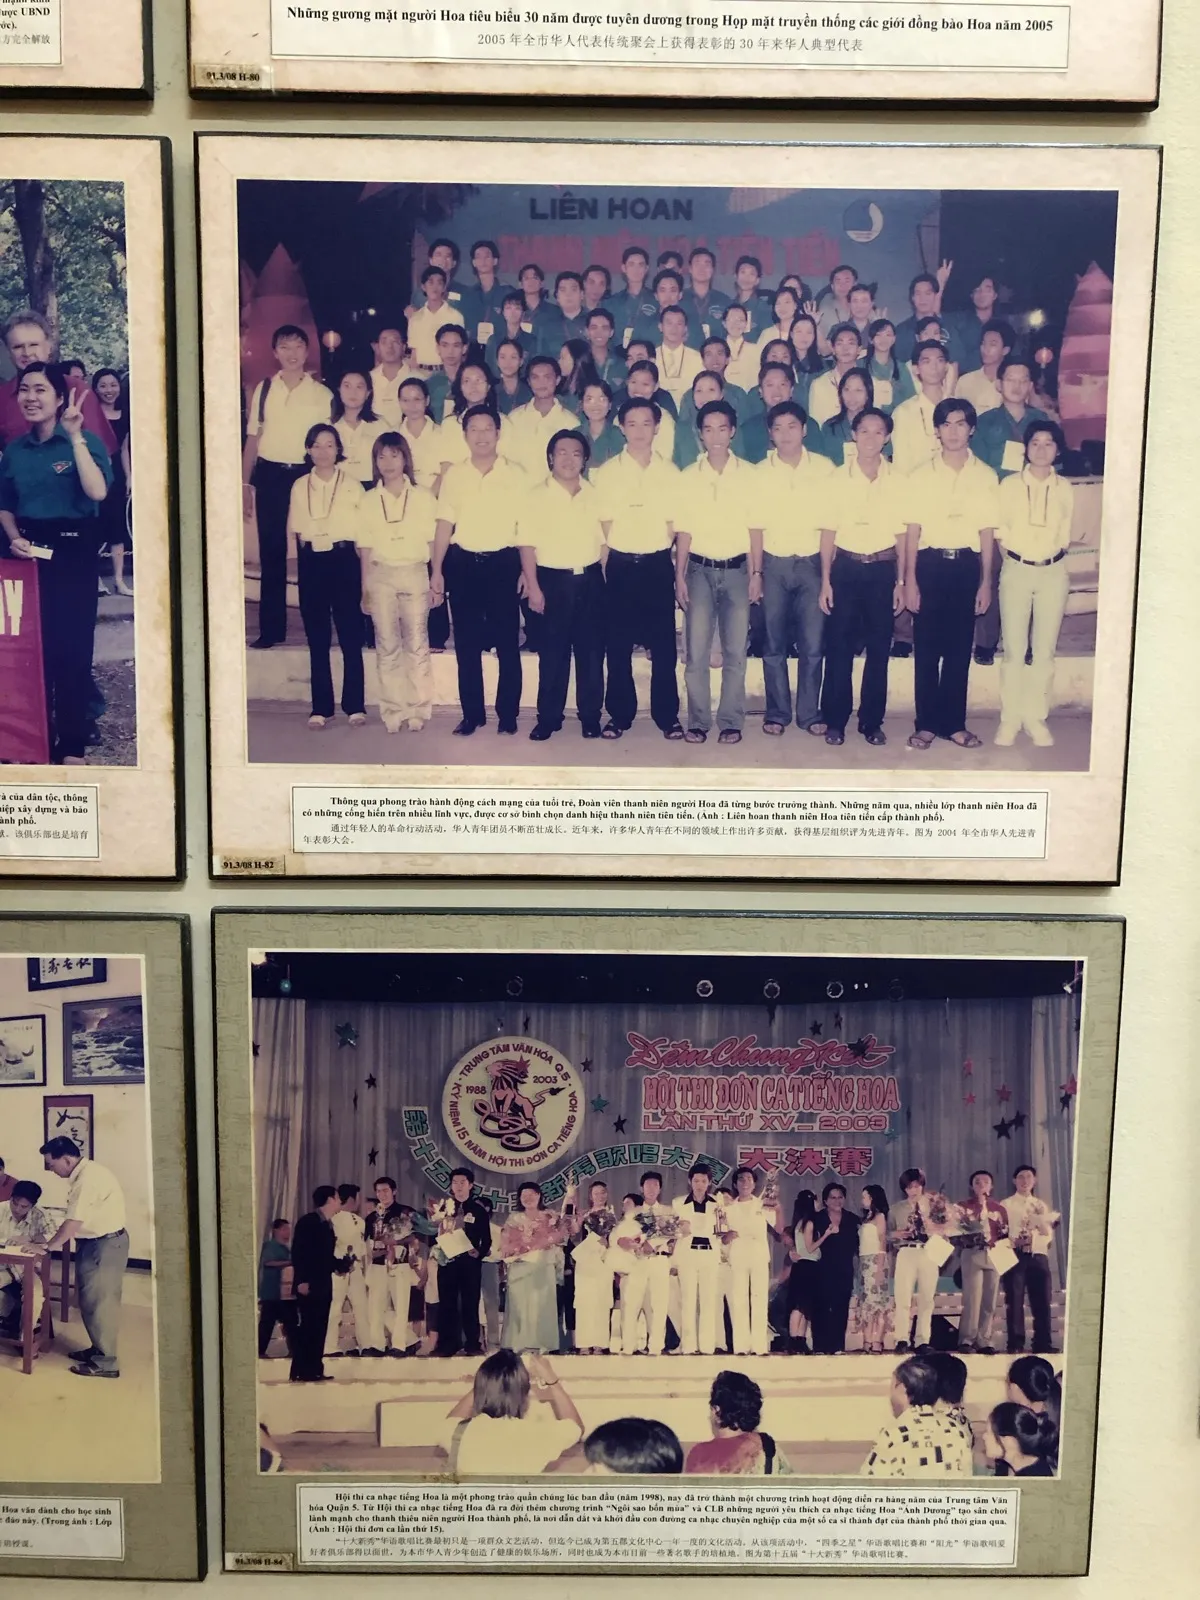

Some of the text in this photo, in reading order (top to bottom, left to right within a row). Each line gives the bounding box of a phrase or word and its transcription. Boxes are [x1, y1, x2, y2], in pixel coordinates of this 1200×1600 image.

[21, 8, 50, 16] UBND
[287, 6, 1053, 32] Những gương mặt người Hoa tiêu biểu 30 năm được tuyên dương trong Họp mặt truyền thống các giới đồng bào Hoa năm 2005
[477, 34, 506, 44] 2005
[740, 38, 754, 48] 30
[530, 192, 694, 220] LIÊN HOAN
[460, 1050, 490, 1077] TRUNG
[490, 1044, 510, 1056] TÂM
[512, 1042, 533, 1054] VĂN
[532, 1046, 554, 1065] HÓA
[466, 1086, 487, 1094] 1988
[532, 1076, 558, 1084] 2003
[643, 1072, 900, 1114] HỘI THI ĐƠN CA TIẾNG HOA
[448, 1100, 461, 1127] NIỆM
[456, 1127, 469, 1140] 15
[464, 1140, 488, 1160] NĂM
[488, 1155, 507, 1167] HỘI
[547, 1142, 561, 1154] CA
[568, 1090, 578, 1112] HOA
[700, 1114, 753, 1130] THỨ
[760, 1115, 795, 1130] XV
[818, 1115, 888, 1130] 2003
[738, 1147, 874, 1176] 大決賽
